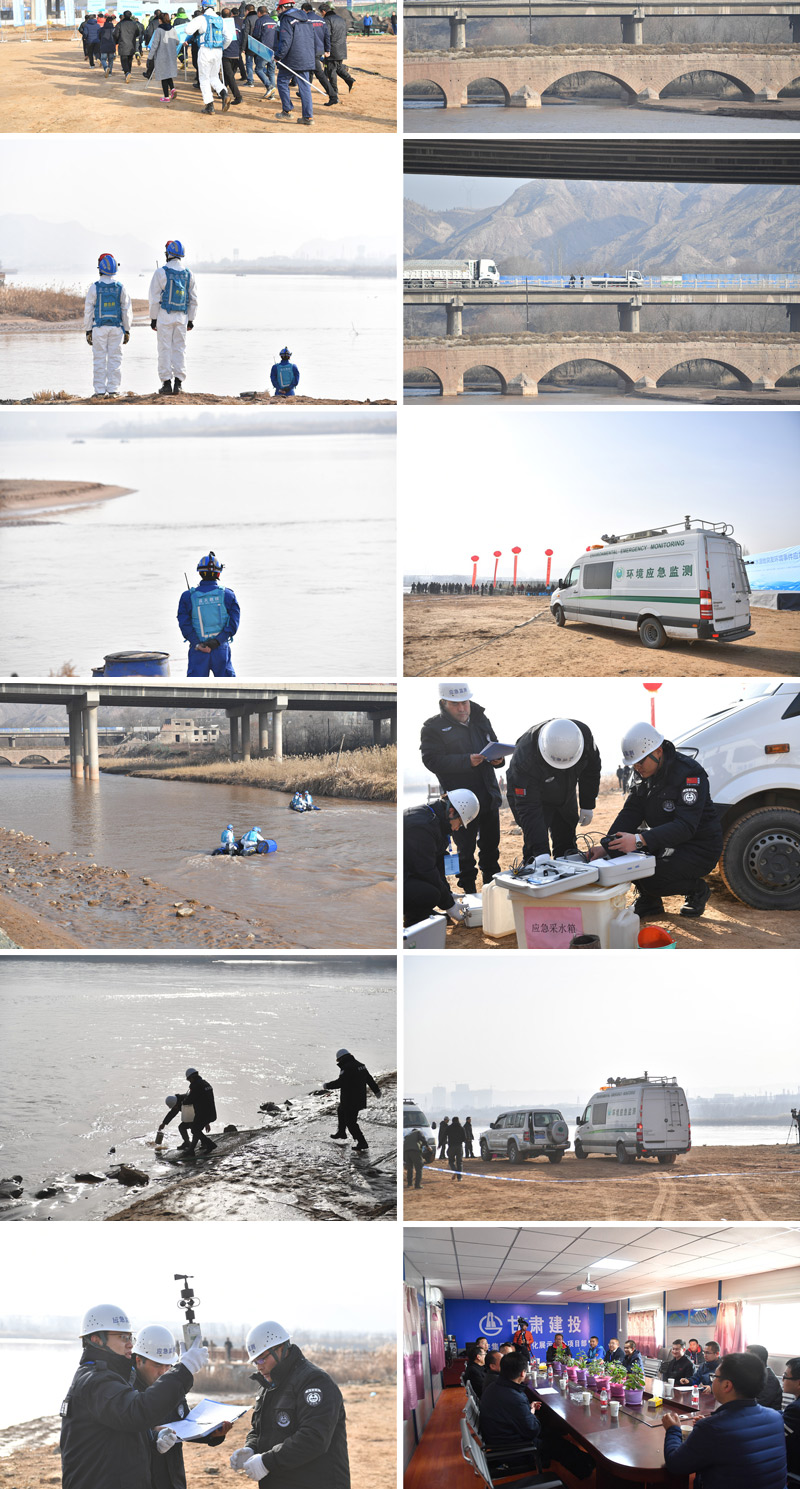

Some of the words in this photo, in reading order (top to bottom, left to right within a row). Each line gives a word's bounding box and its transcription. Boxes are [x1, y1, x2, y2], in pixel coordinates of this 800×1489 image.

[620, 545, 647, 554] EMERGENCY
[650, 539, 685, 550] MONITORING
[626, 564, 693, 579] 环境应急监测
[531, 923, 576, 934] 应急采水箱
[507, 1315, 582, 1335] 甘肃建投
